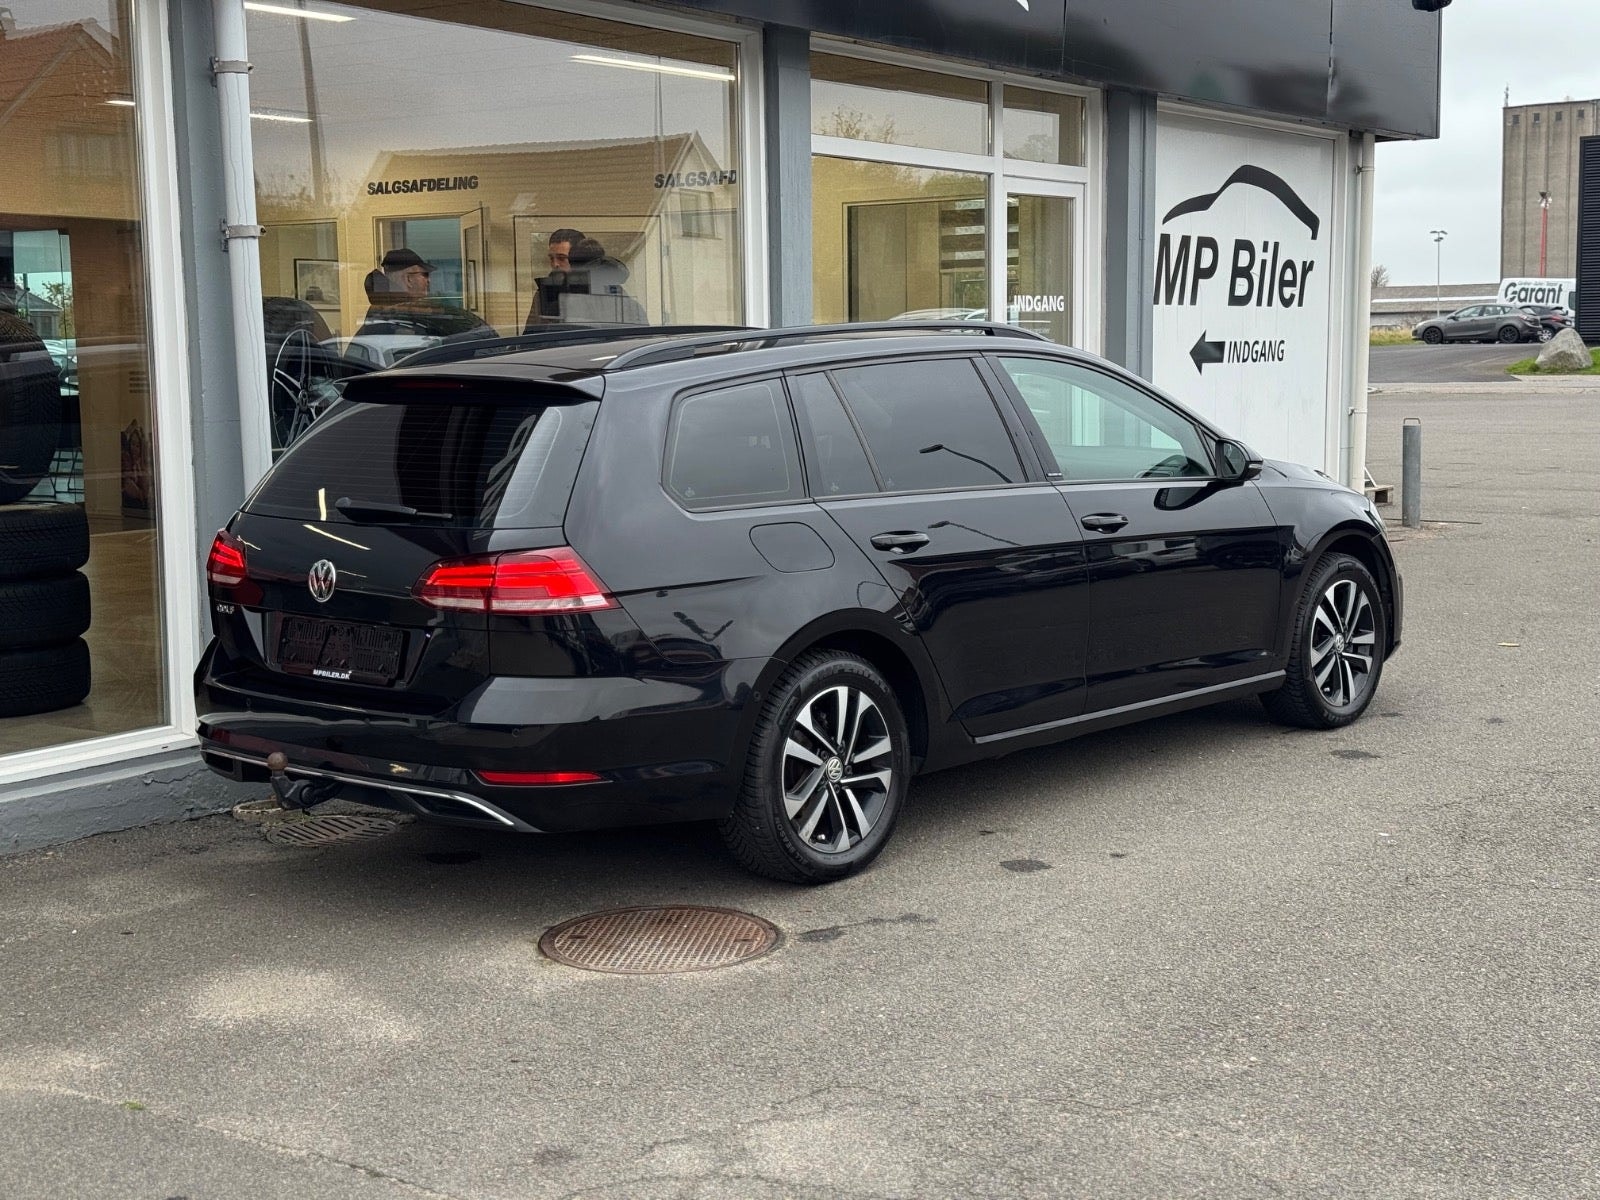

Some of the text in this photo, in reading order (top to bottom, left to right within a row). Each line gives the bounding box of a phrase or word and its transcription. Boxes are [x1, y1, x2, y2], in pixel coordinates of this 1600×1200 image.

[367, 175, 479, 196] SALGSAFDELING
[1153, 233, 1315, 308] MP Biler
[1013, 294, 1065, 313] INDGANG
[1504, 282, 1564, 305] Garant
[1227, 339, 1285, 364] INDGANG
